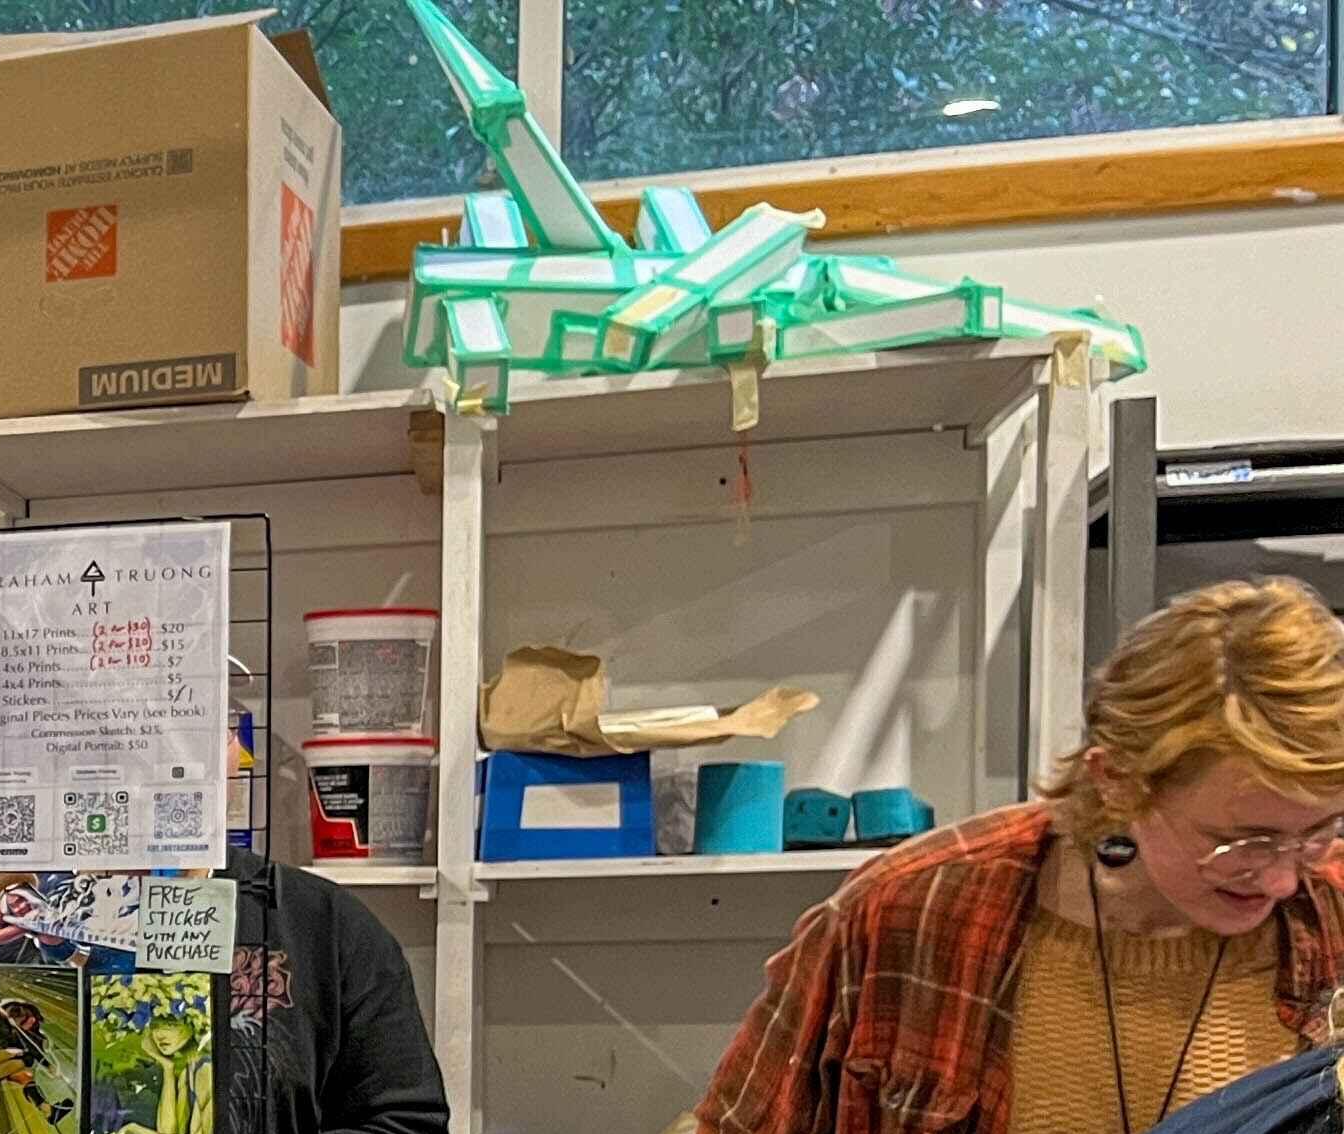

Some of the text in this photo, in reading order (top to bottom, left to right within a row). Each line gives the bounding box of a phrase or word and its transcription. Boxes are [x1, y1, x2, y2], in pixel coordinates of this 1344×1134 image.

[91, 362, 223, 397] MEDIUM
[115, 565, 212, 582] TRUONG
[72, 600, 112, 616] ART
[2, 628, 39, 641] 11x17
[43, 627, 77, 639] Prints
[161, 622, 185, 634] $20
[46, 644, 79, 656] Prints
[161, 639, 185, 650] $15
[2, 661, 24, 674] 4x6
[28, 660, 62, 673] Prints
[167, 655, 183, 667] $7
[2, 673, 183, 690] 4x4 Prints $5
[2, 694, 47, 706] Stickers
[32, 709, 70, 722] Pieces
[74, 708, 109, 720] Prices
[112, 708, 140, 722] Vary
[143, 707, 167, 720] (see
[46, 739, 149, 755] Digital Portrait: $50
[148, 885, 202, 909] FREE
[146, 907, 221, 927] STICKER
[143, 930, 212, 943] WITH ANY
[146, 942, 223, 962] PURCHASE
